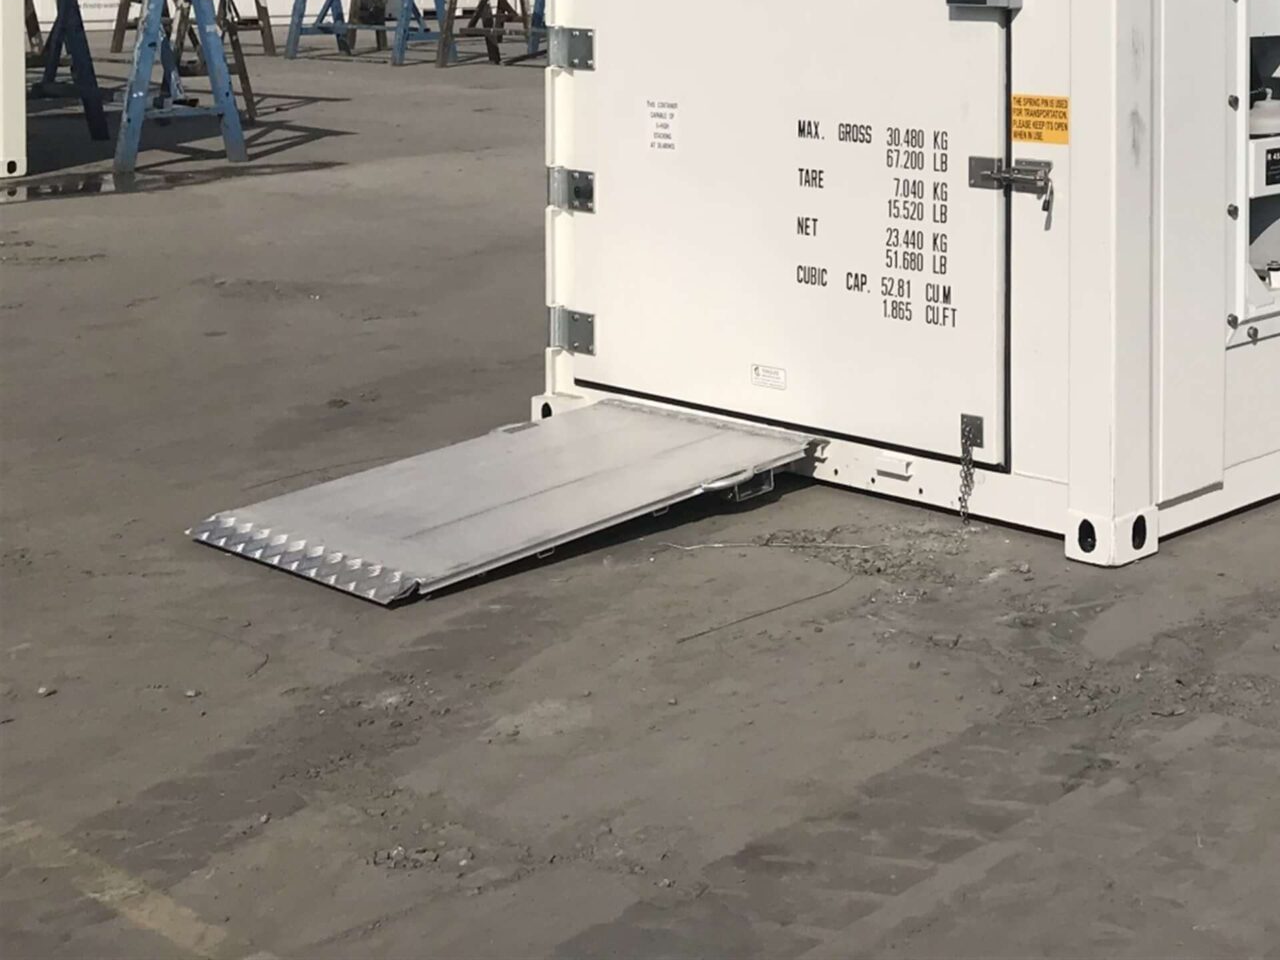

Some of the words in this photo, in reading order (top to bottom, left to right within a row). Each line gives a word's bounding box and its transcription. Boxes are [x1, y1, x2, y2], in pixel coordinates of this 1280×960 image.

[798, 120, 825, 140] MAX.
[839, 123, 872, 144] GROSS
[887, 127, 925, 149] 30.480
[933, 130, 948, 150] KG
[887, 149, 924, 170] 67.200
[933, 152, 948, 173] LB
[798, 168, 824, 189] TARE
[893, 178, 924, 199] 7.040
[933, 182, 948, 202] KG
[888, 200, 924, 221] 15.520
[933, 204, 947, 224] LB
[797, 217, 818, 236] NET
[886, 227, 924, 250] 23.440
[933, 233, 947, 253] KG
[886, 249, 923, 272] 51.680
[932, 255, 947, 275] LB
[797, 265, 828, 287] CUBIC
[846, 272, 870, 293] CAP.
[881, 277, 911, 299] 52.81
[926, 283, 951, 305] CU.M
[883, 299, 912, 321] 1.865
[926, 305, 957, 328] CU.FT
